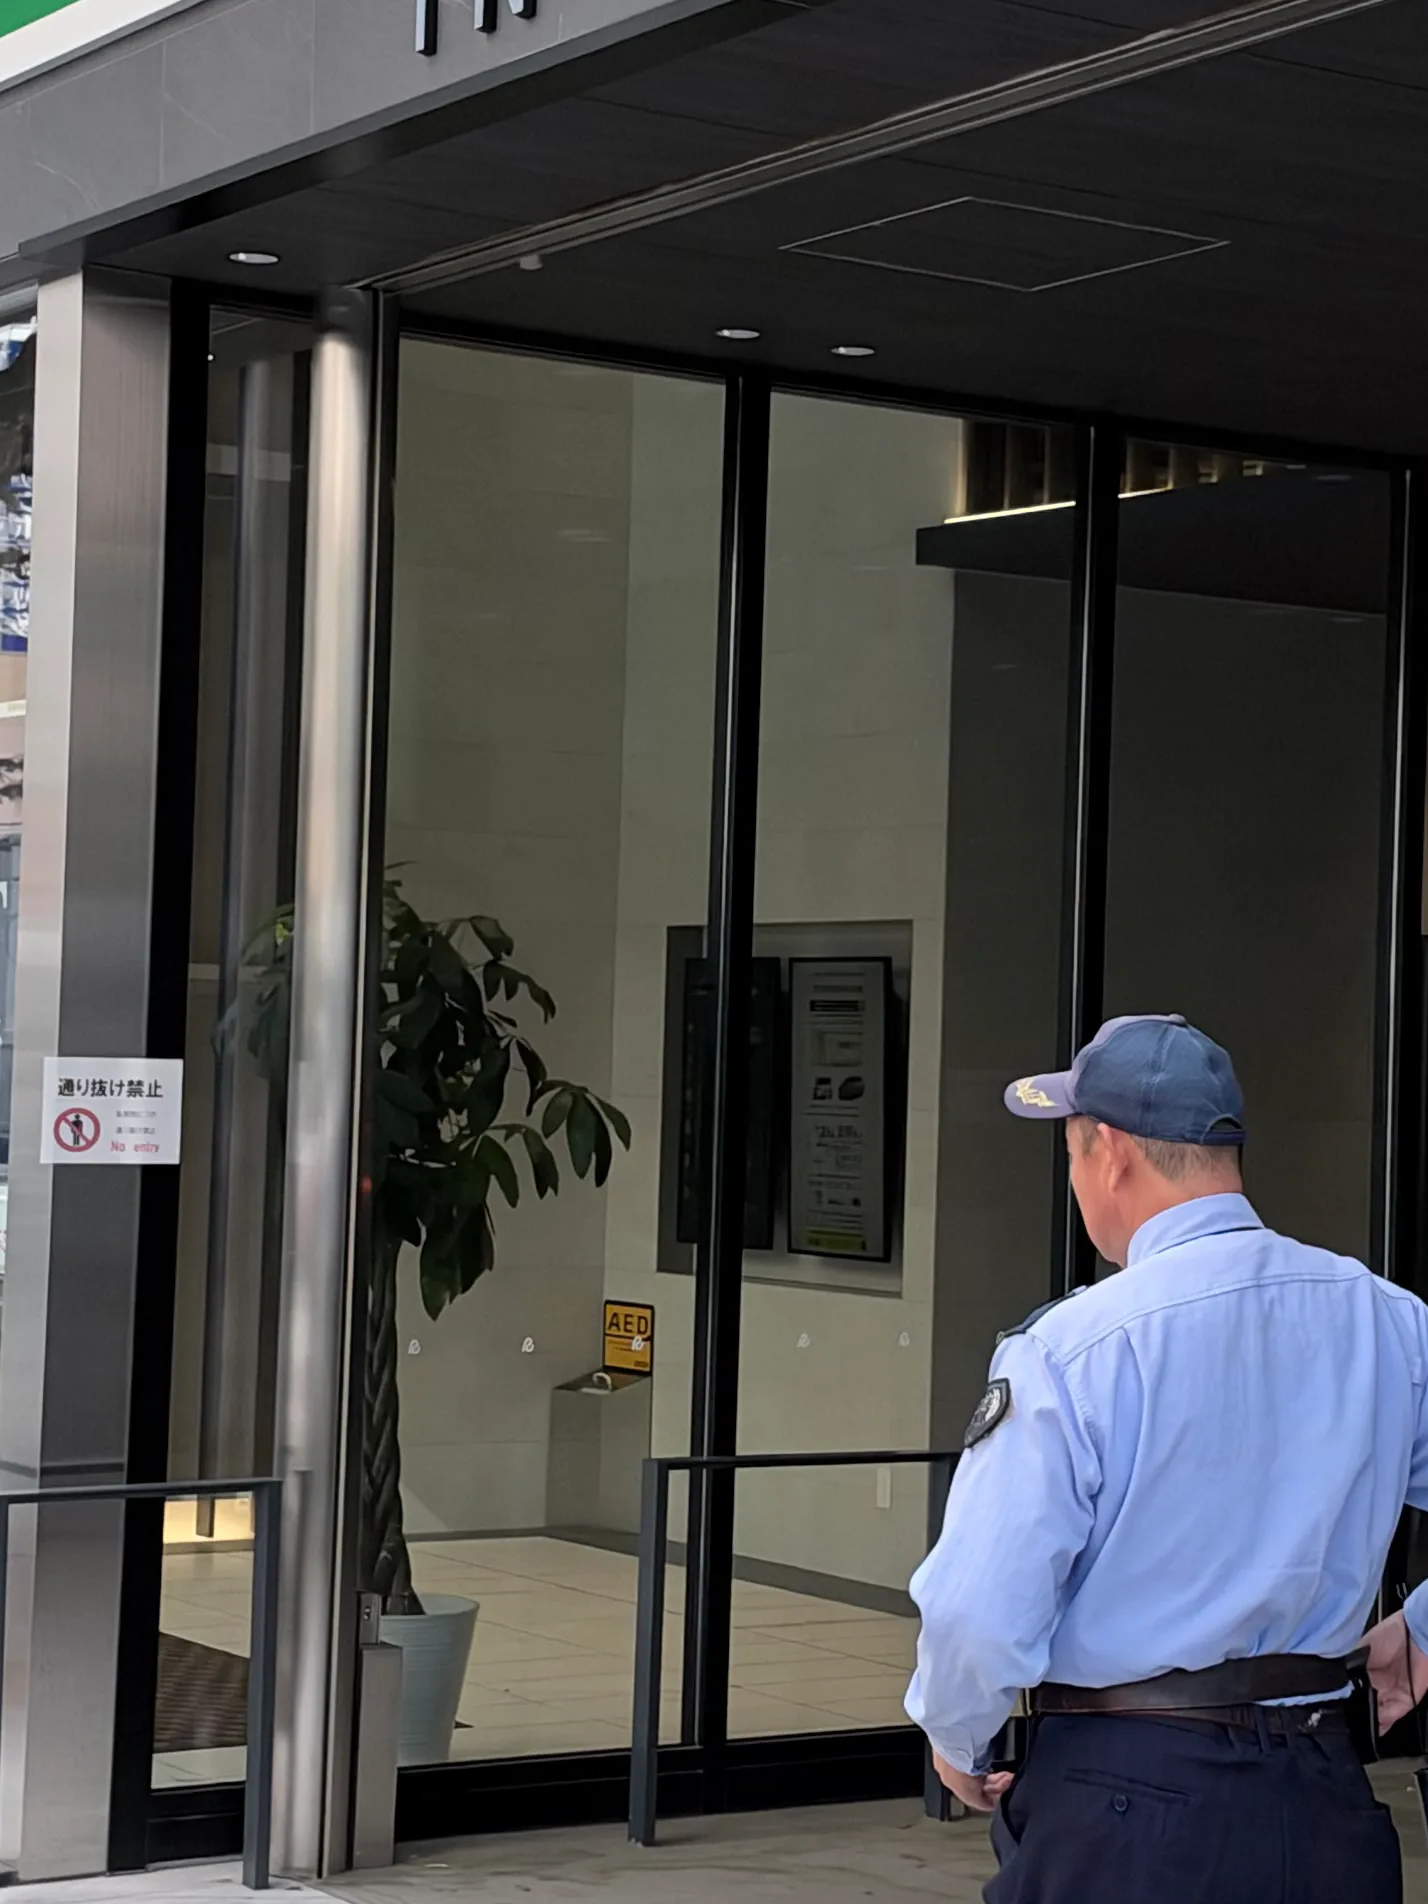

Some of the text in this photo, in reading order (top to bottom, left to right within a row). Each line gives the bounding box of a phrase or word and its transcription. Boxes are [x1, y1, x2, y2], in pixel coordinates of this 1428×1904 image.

[58, 1078, 163, 1098] 通り抜け禁止
[110, 1139, 160, 1153] No entry
[607, 1312, 649, 1335] AED
